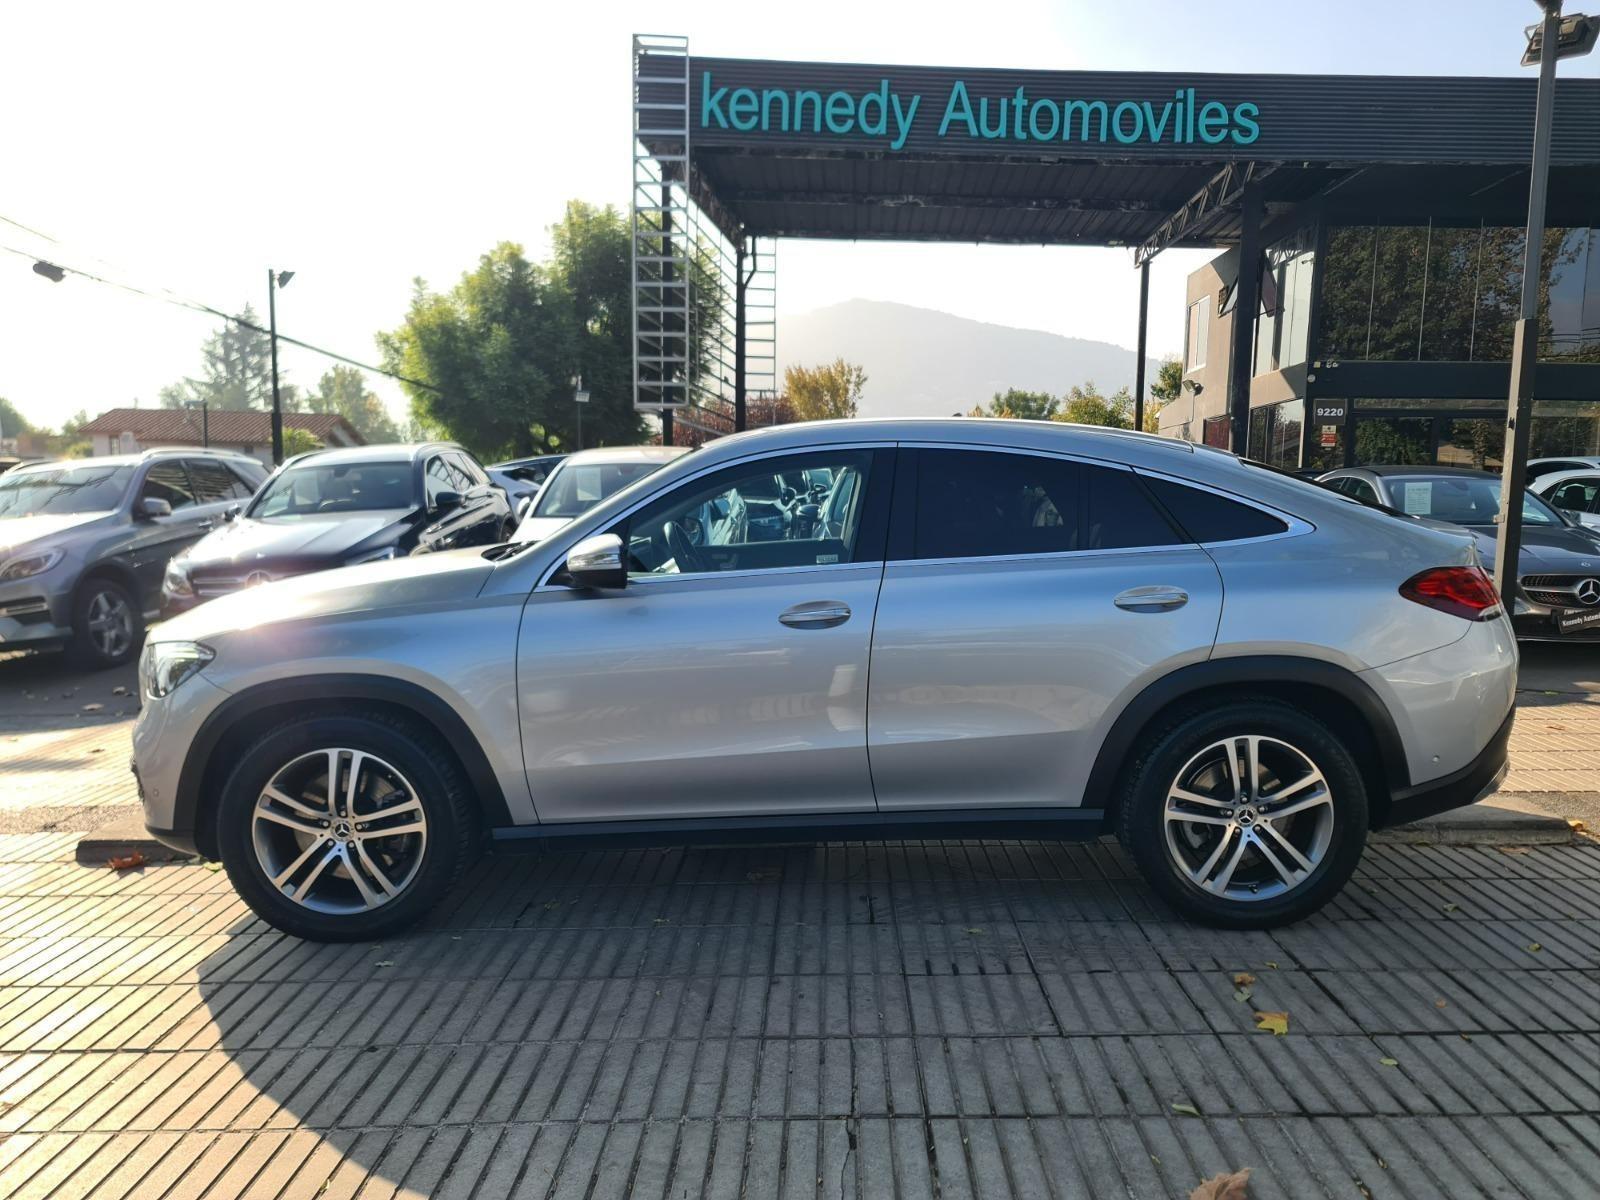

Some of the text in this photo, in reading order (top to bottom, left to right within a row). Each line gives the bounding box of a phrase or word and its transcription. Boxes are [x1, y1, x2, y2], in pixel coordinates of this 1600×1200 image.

[702, 71, 1260, 150] kennedy Automoviles
[1317, 407, 1344, 417] 9220
